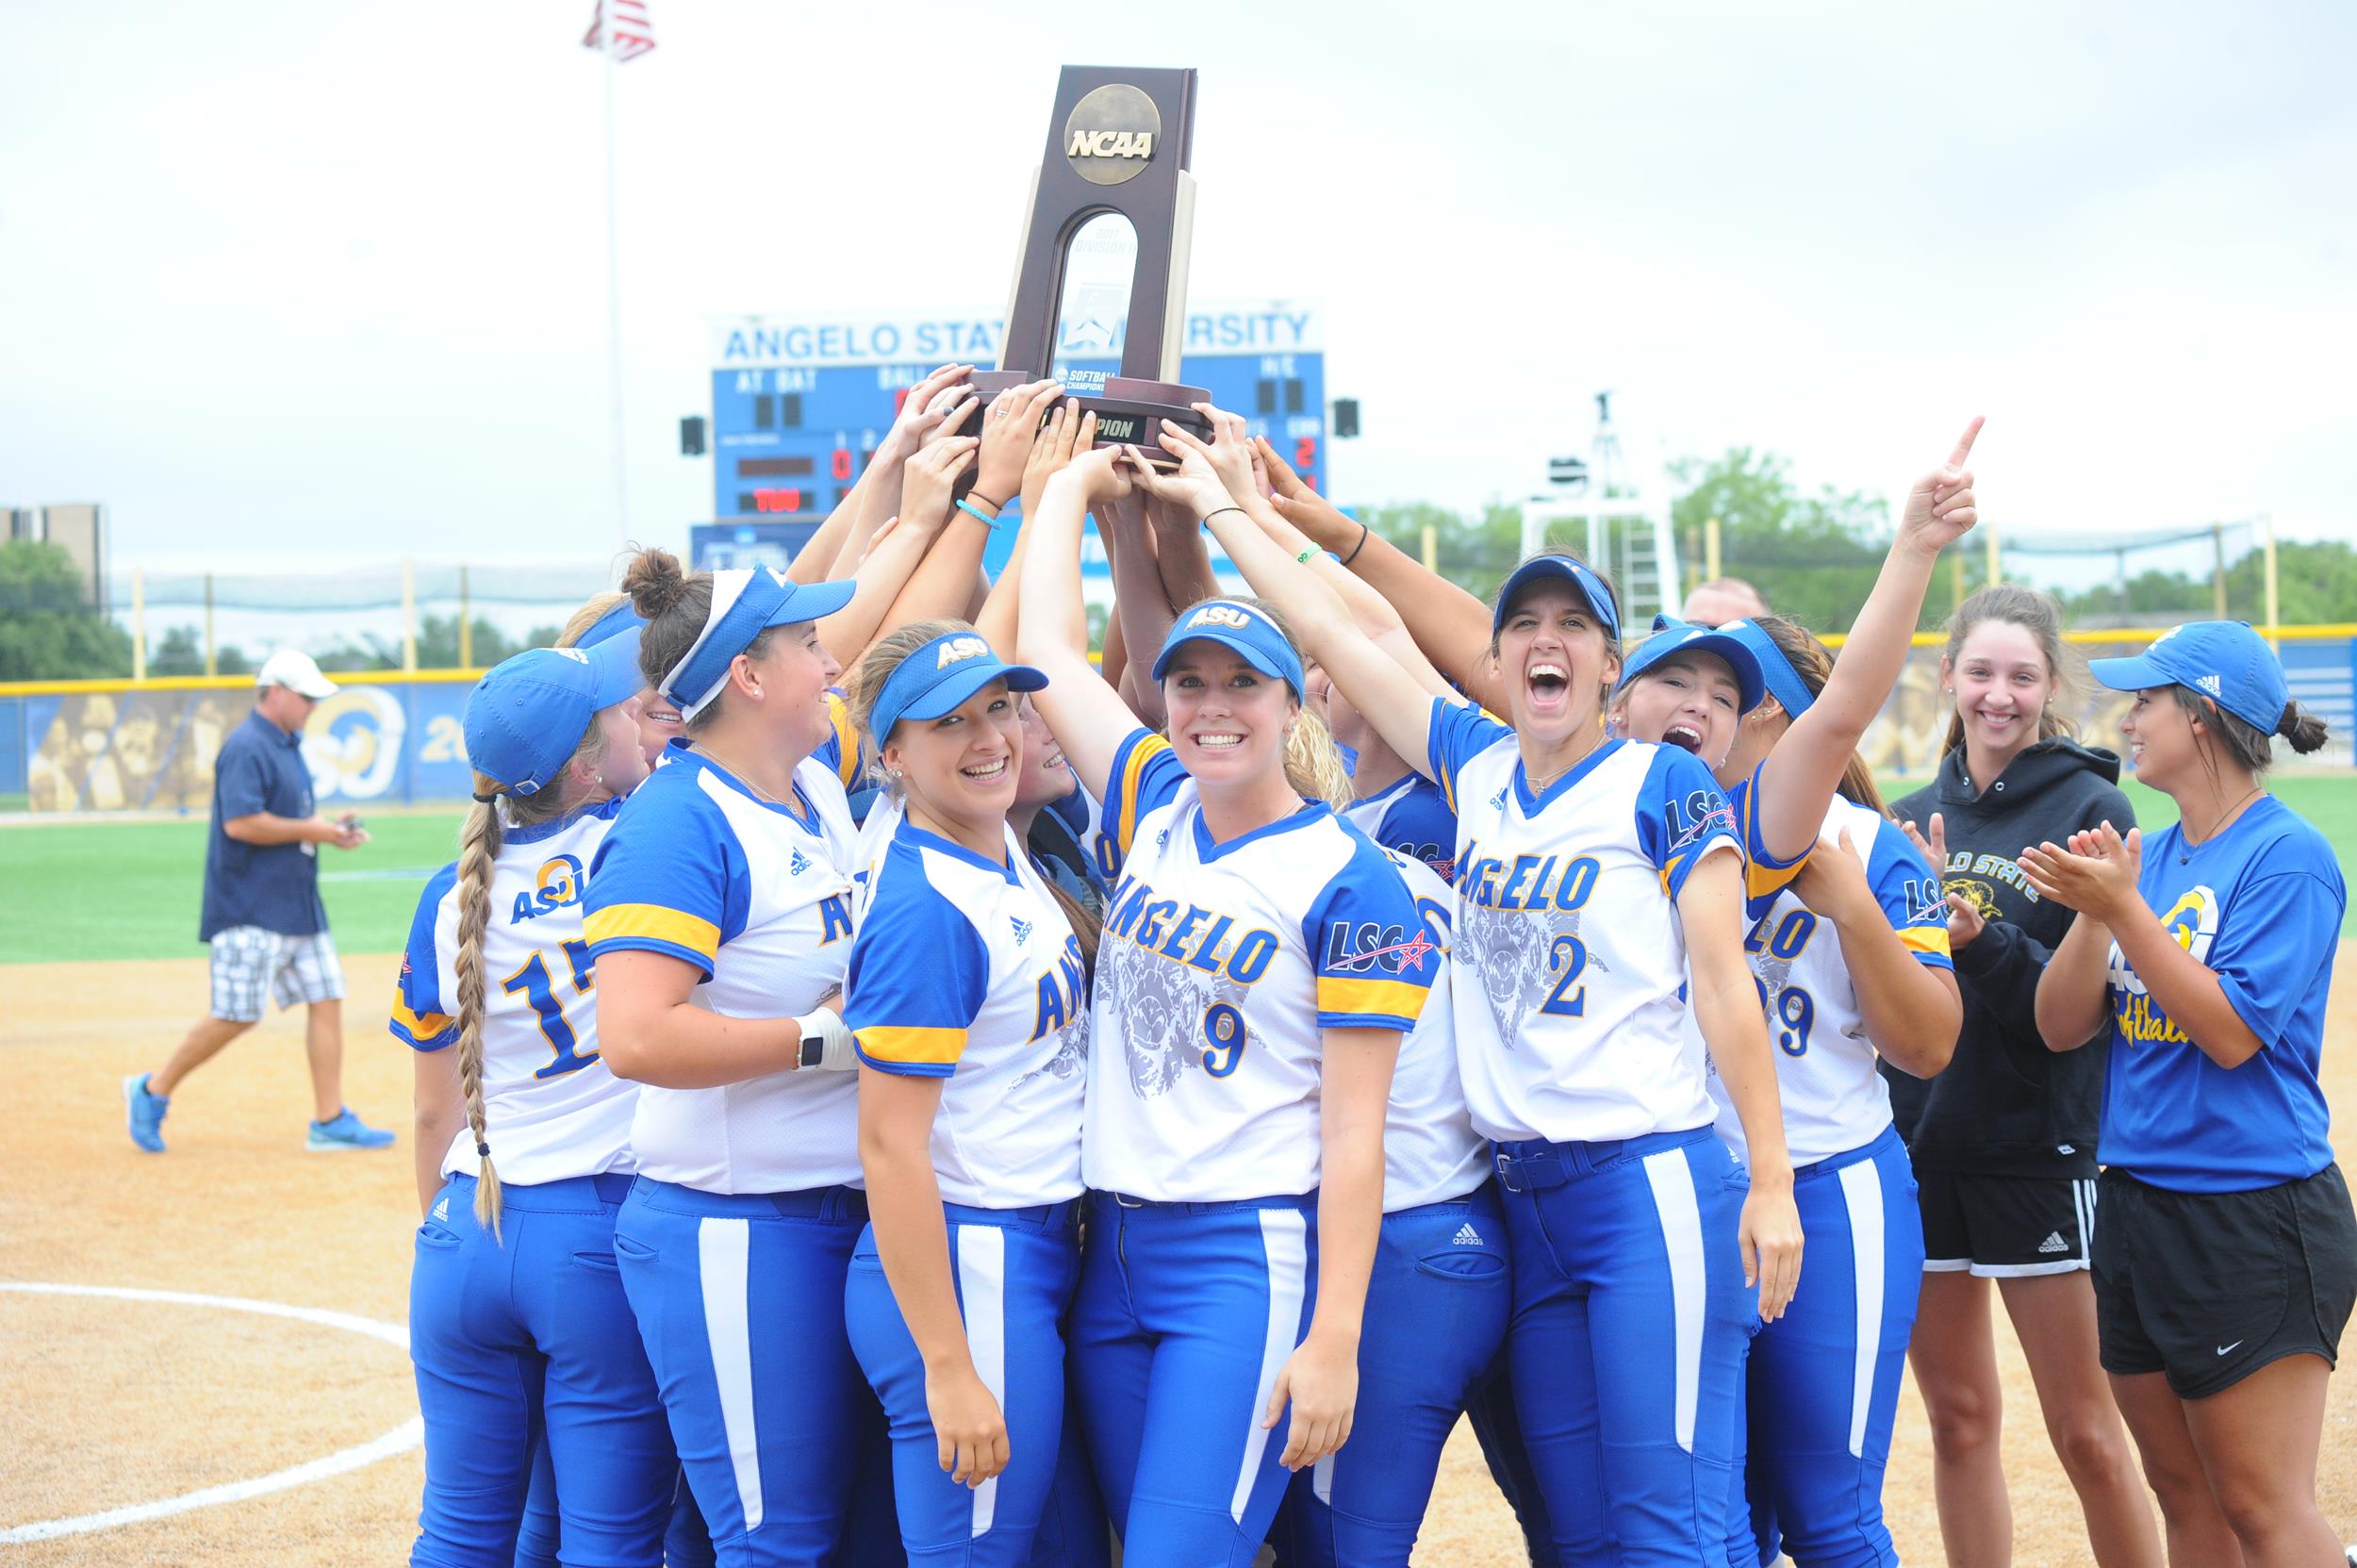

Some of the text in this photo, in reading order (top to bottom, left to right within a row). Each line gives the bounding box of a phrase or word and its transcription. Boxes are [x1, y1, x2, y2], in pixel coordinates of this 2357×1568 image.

[1068, 130, 1153, 159] NCAA
[1075, 239, 1124, 255] DIVISION
[724, 324, 901, 360] ANGELO
[915, 320, 1003, 357] STA
[1095, 418, 1133, 438] PION
[1183, 606, 1252, 631] ASU
[937, 637, 988, 670] ASU
[1904, 878, 1948, 925] LS
[1327, 920, 1405, 973] LSC
[1538, 932, 1590, 1018] 2
[1199, 999, 1250, 1081] 9
[1453, 1237, 1484, 1246] adidas
[2038, 1244, 2069, 1253] adidas
